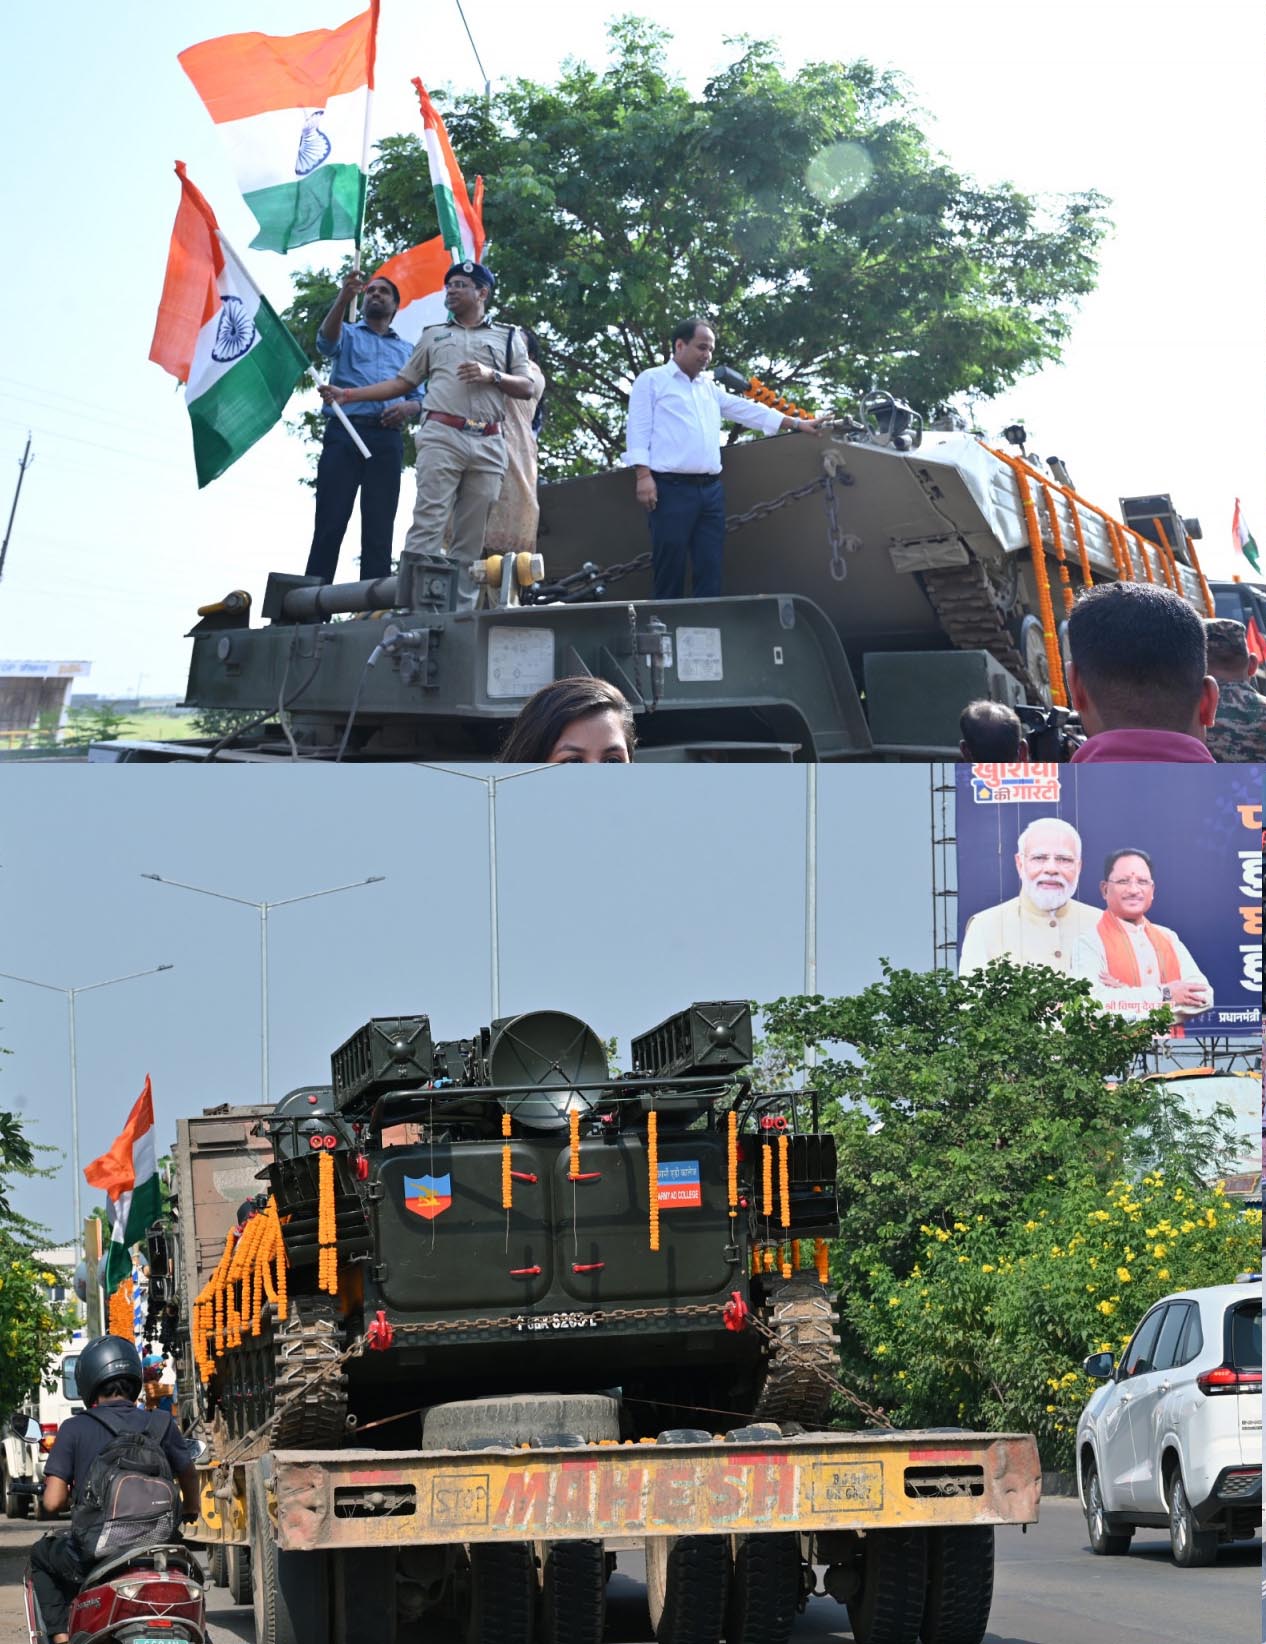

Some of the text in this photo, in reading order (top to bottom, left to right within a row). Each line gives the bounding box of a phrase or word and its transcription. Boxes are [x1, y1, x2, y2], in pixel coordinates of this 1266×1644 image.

[994, 780, 1058, 800] की गारंटी
[1218, 1009, 1260, 1023] प्रधानमंत्री
[658, 1189, 699, 1200] ARMY AD COLLEGE
[436, 1485, 489, 1514] STOP
[493, 1464, 800, 1531] MAHESH
